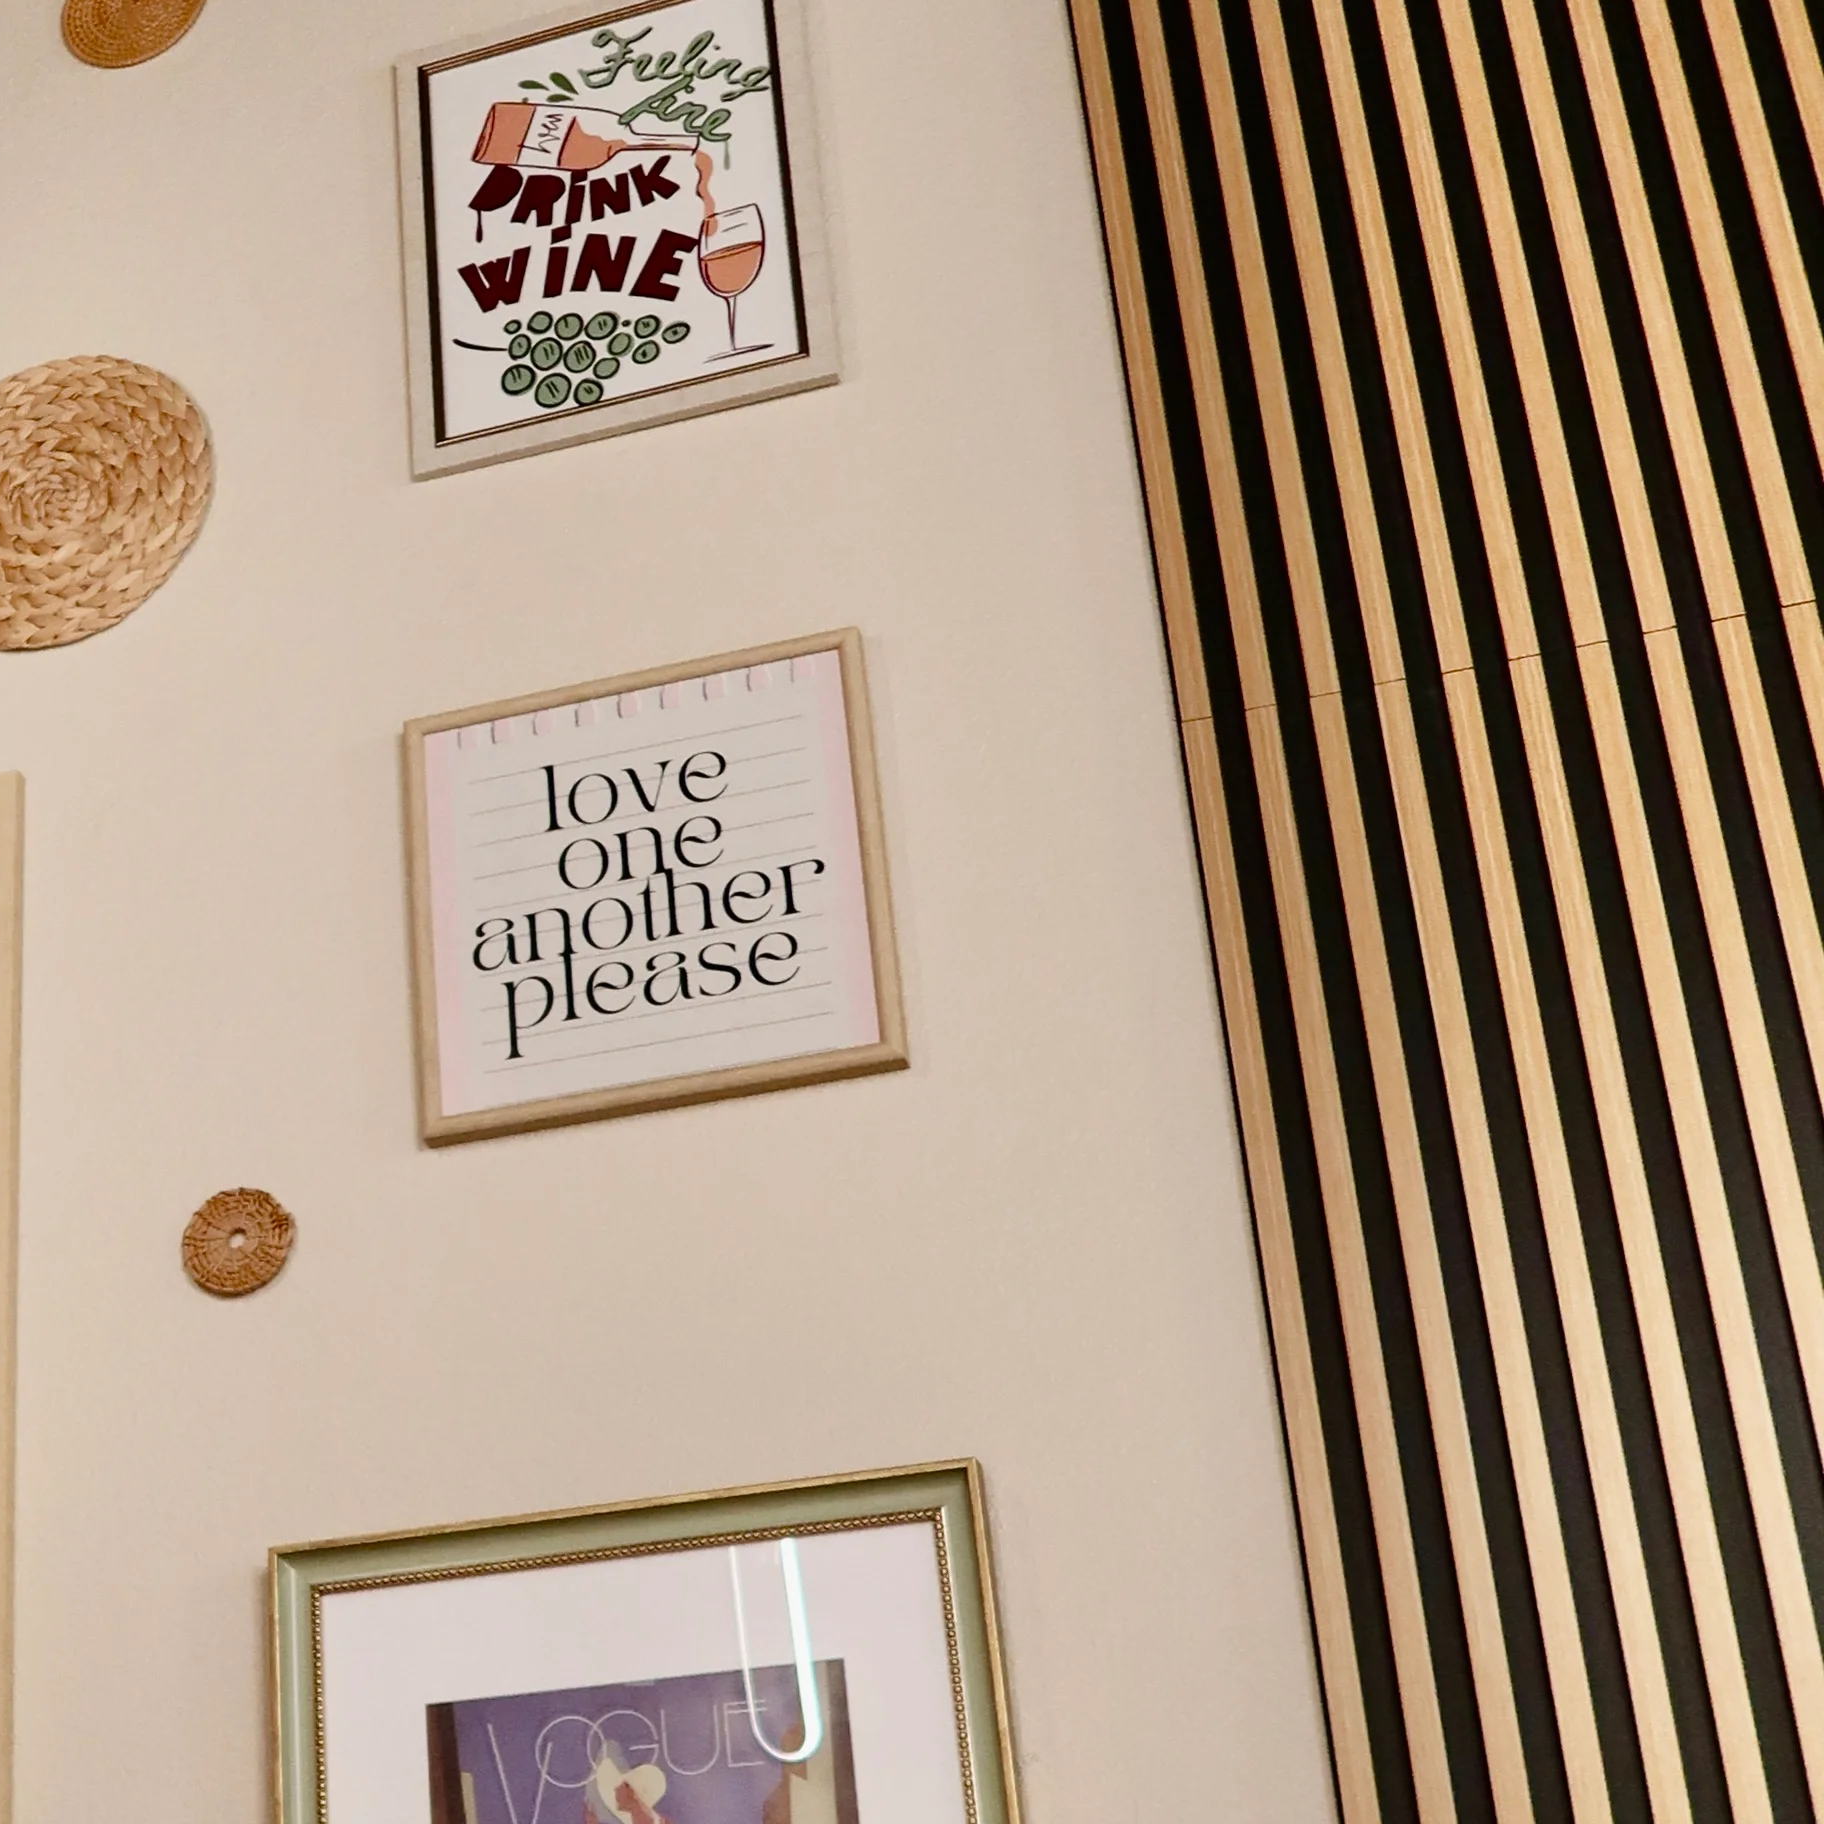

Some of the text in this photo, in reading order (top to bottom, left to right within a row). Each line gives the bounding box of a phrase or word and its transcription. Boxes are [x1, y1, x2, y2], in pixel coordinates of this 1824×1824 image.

[578, 26, 771, 102] Feeling
[541, 750, 728, 832] love
[557, 815, 724, 890] one
[472, 858, 825, 971] another
[501, 931, 801, 1060] please
